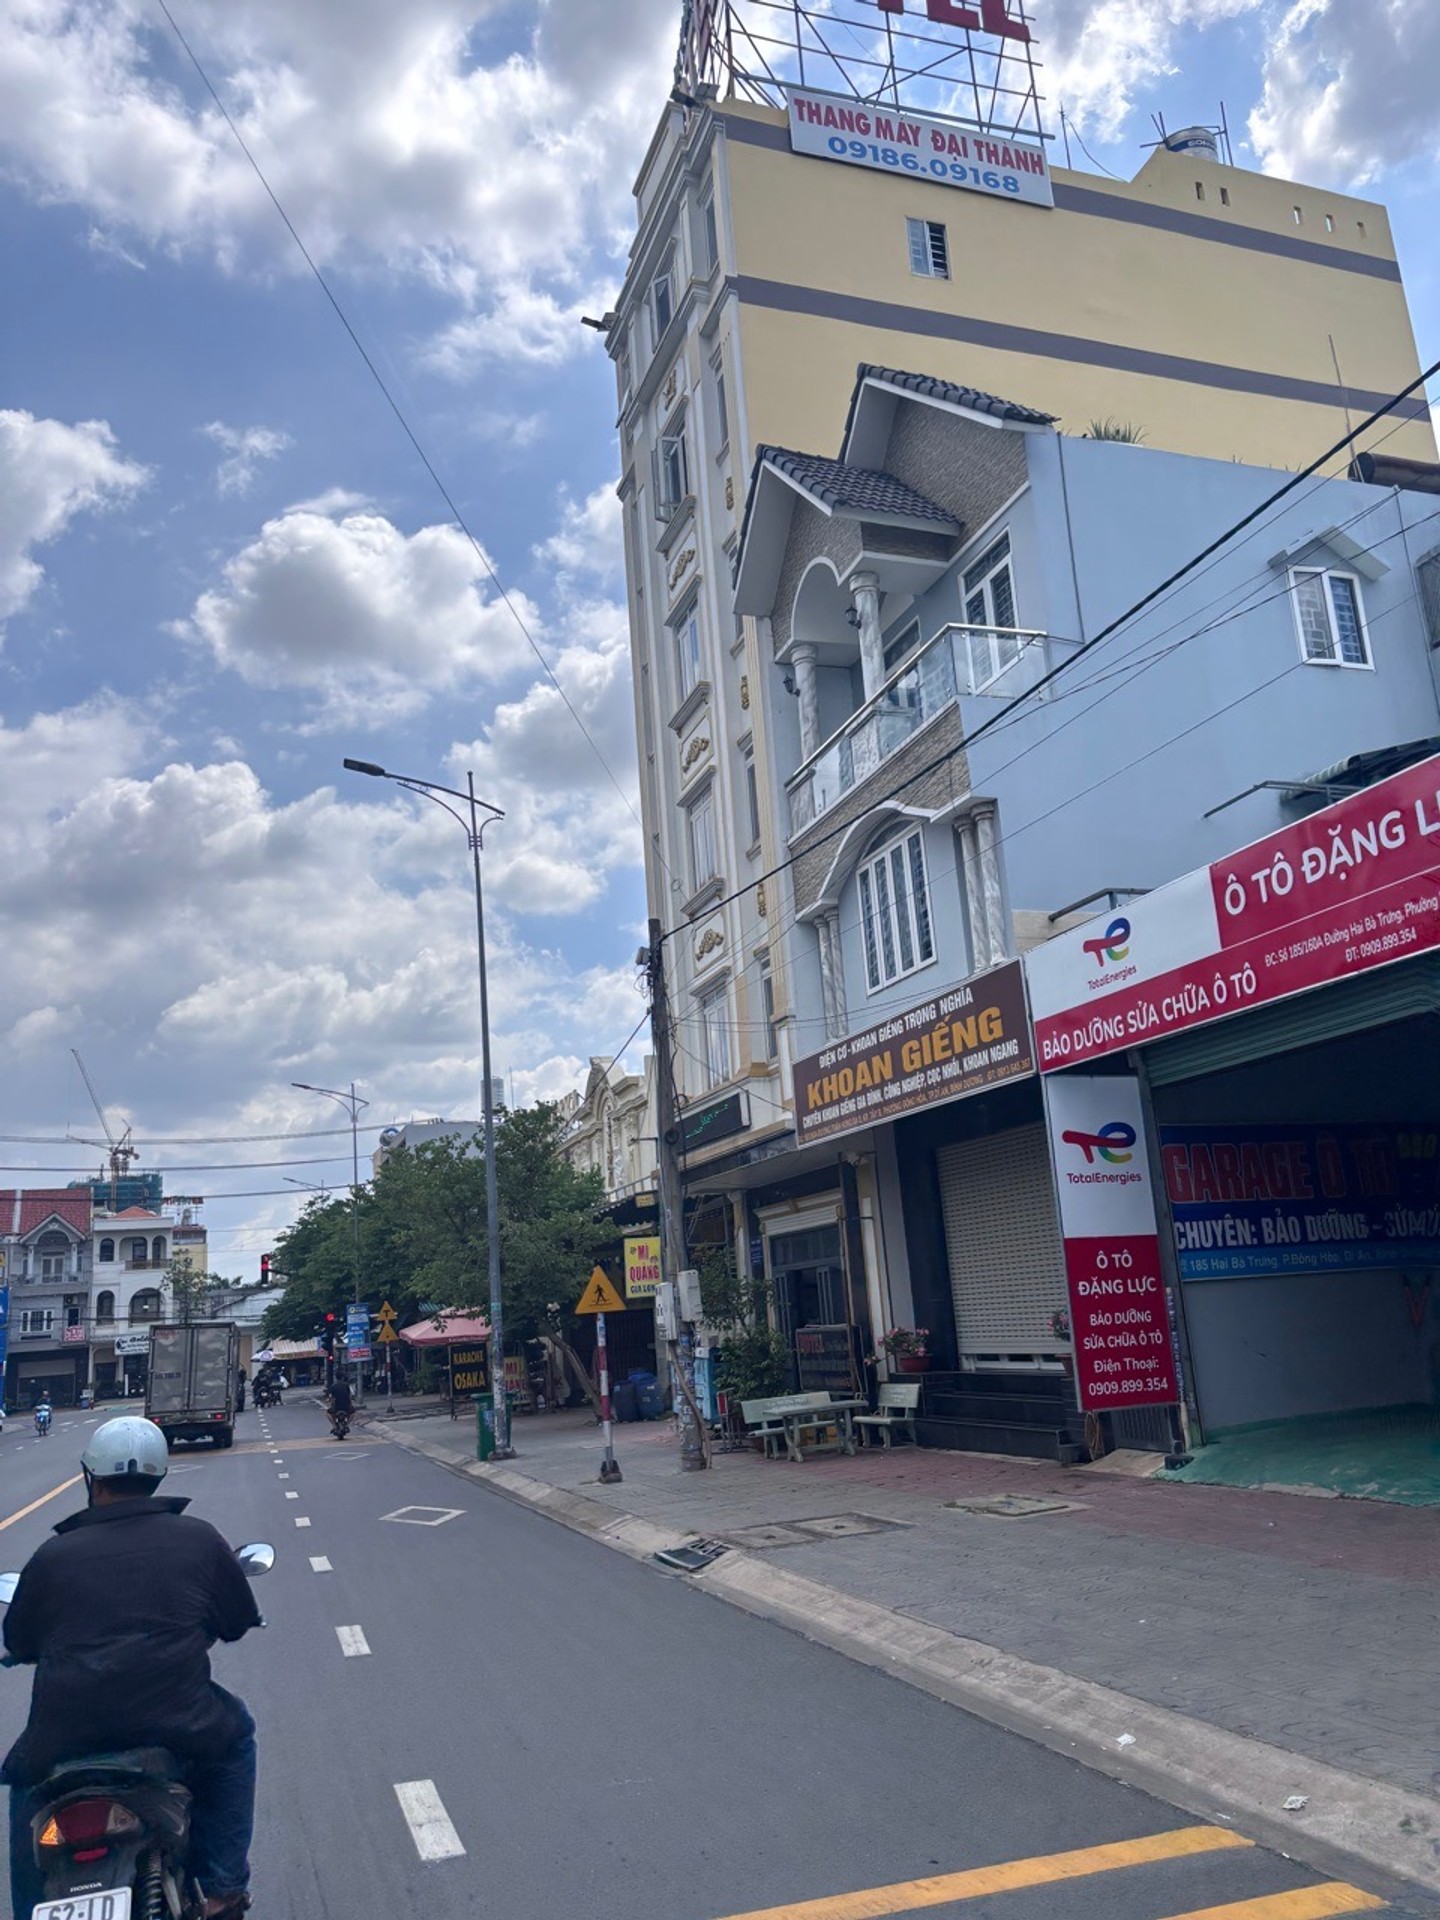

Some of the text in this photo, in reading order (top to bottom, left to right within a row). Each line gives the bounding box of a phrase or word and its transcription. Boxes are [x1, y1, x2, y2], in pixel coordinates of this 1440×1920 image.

[794, 98, 1045, 176] THANG MÁY ĐẠI THÀNH
[828, 136, 1020, 194] 09186.09168
[1224, 873, 1246, 915] Ô
[1251, 851, 1294, 904] TÔ
[1301, 811, 1406, 884] ĐẶNG
[1289, 935, 1324, 959] 185/160A
[1324, 928, 1350, 946] Đường
[1349, 920, 1365, 937] Hai
[1364, 915, 1377, 931] Bà
[1404, 897, 1439, 917] Phường
[1345, 926, 1417, 963] ĐT: 0909.899.354
[1087, 964, 1137, 991] TotalEnergies
[904, 1003, 937, 1030] TRỌNG
[939, 986, 974, 1016] NGHĨA
[1042, 962, 1257, 1061] BẢO DƯỠNG SỬA CHỮA Ô TÔ
[806, 1006, 1004, 1110] KHOAN GIẾNG
[990, 1038, 1019, 1063] NGANG
[1067, 1172, 1143, 1185] TotalEnergies
[1161, 1141, 1314, 1204] GARAGE
[1174, 1213, 1257, 1250] CHUYÊN:
[1261, 1207, 1301, 1245] BẢO
[1305, 1208, 1369, 1243] DƯỠNG
[1096, 1249, 1133, 1269] Ô TÔ
[1190, 1259, 1208, 1272] 185
[1211, 1256, 1229, 1270] Hai
[1078, 1276, 1157, 1299] ĐẶNG LỰC
[1089, 1308, 1152, 1326] BẢO DƯỠNG
[1083, 1329, 1163, 1350] SỬA CHỮA Ô TÔ
[1093, 1356, 1160, 1376] Điện Thoại:
[454, 1370, 486, 1390] OSAKA
[1088, 1377, 1168, 1396] 0909.899.354
[70, 1882, 103, 1893] HONDA
